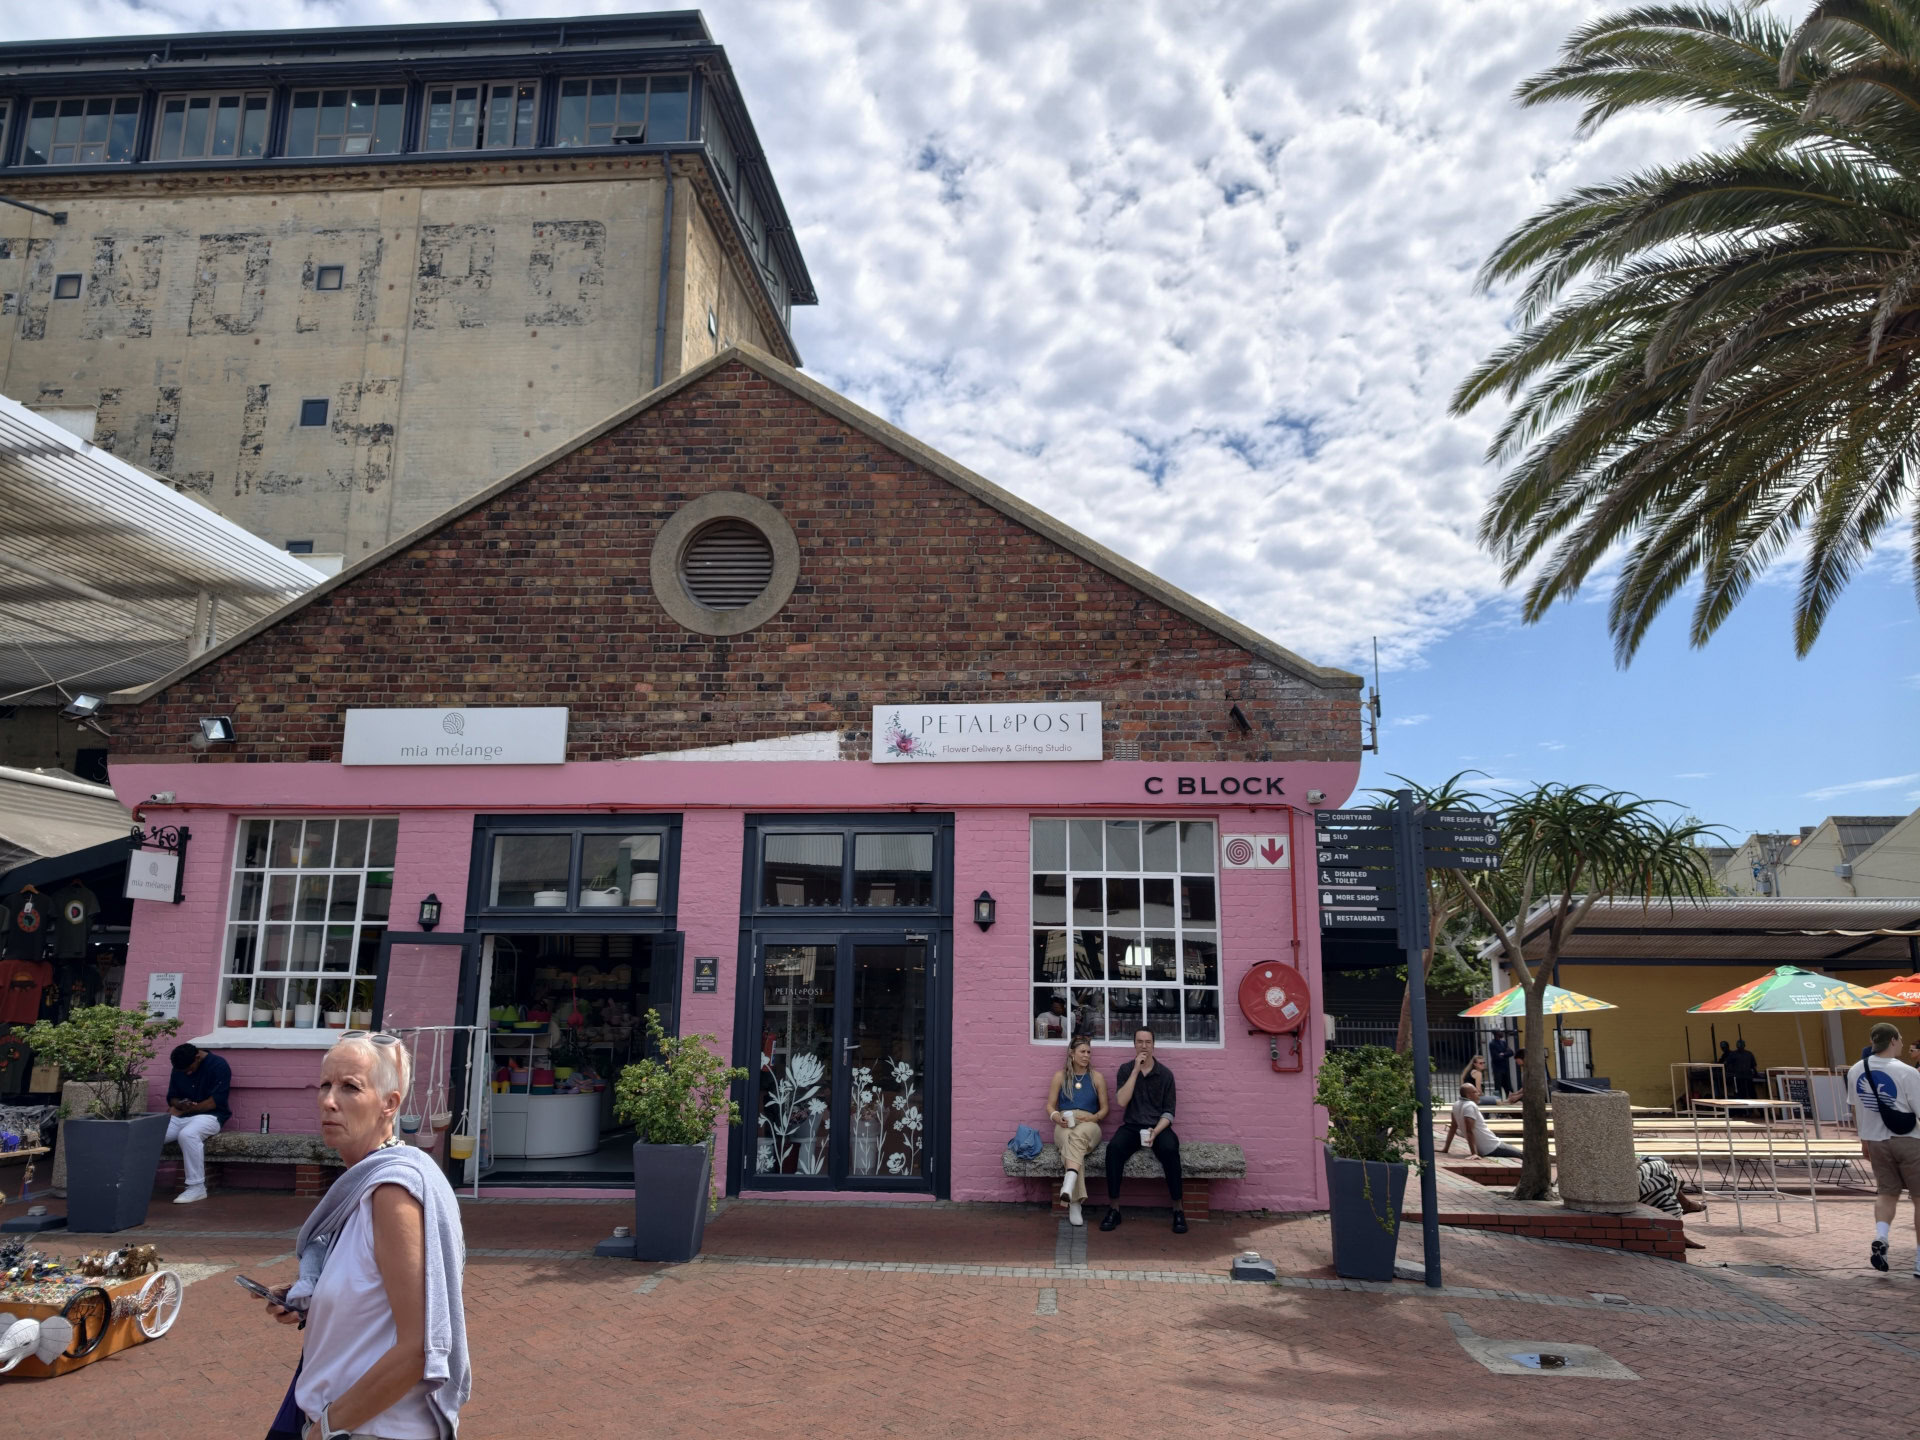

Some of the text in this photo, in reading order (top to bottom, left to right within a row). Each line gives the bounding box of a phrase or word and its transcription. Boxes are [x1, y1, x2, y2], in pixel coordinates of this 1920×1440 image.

[400, 742, 503, 761] mia mélange
[942, 744, 970, 753] Flower
[971, 744, 1004, 754] Delivery
[1014, 743, 1044, 754] Gifting
[1045, 743, 1073, 752] Studio
[1144, 776, 1286, 796] C BLOCK
